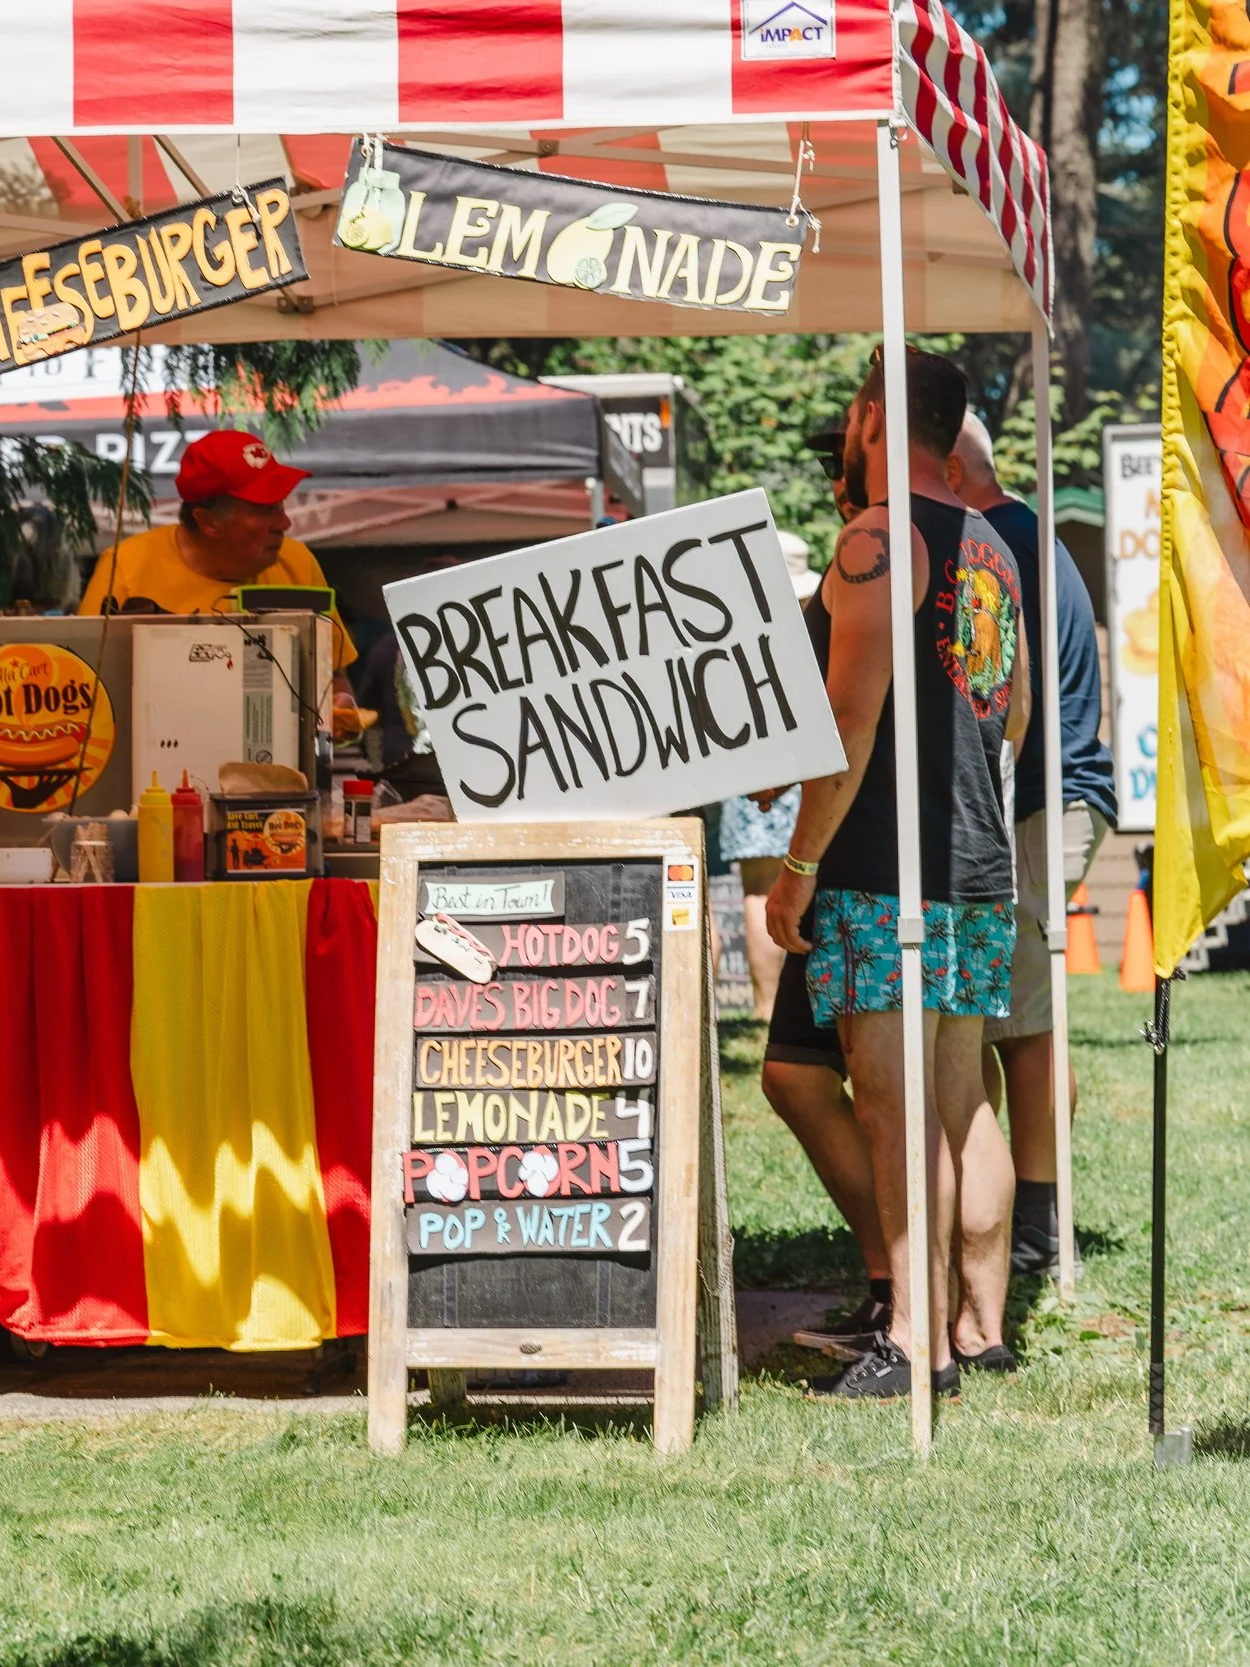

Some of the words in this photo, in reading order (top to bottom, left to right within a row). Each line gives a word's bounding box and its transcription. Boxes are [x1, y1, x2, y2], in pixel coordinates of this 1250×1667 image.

[397, 520, 768, 710] BREAKFAST
[22, 680, 93, 716] Dogs
[452, 633, 798, 808] SANDWICH
[498, 924, 620, 967] HOTDOG
[622, 918, 650, 965] 5
[413, 981, 506, 1031] DAVES
[512, 979, 561, 1030] BIG
[565, 978, 622, 1029] DOG
[624, 982, 650, 1019] 7
[419, 1035, 623, 1089] CHEESEBURGER
[621, 1037, 653, 1080] 10
[413, 1090, 610, 1144] LEMONADE
[614, 1090, 652, 1139] 4
[618, 1138, 655, 1193] 5
[418, 1207, 487, 1250] POP
[494, 1208, 512, 1245] &
[515, 1202, 613, 1249] WATER
[618, 1200, 648, 1252] 2
